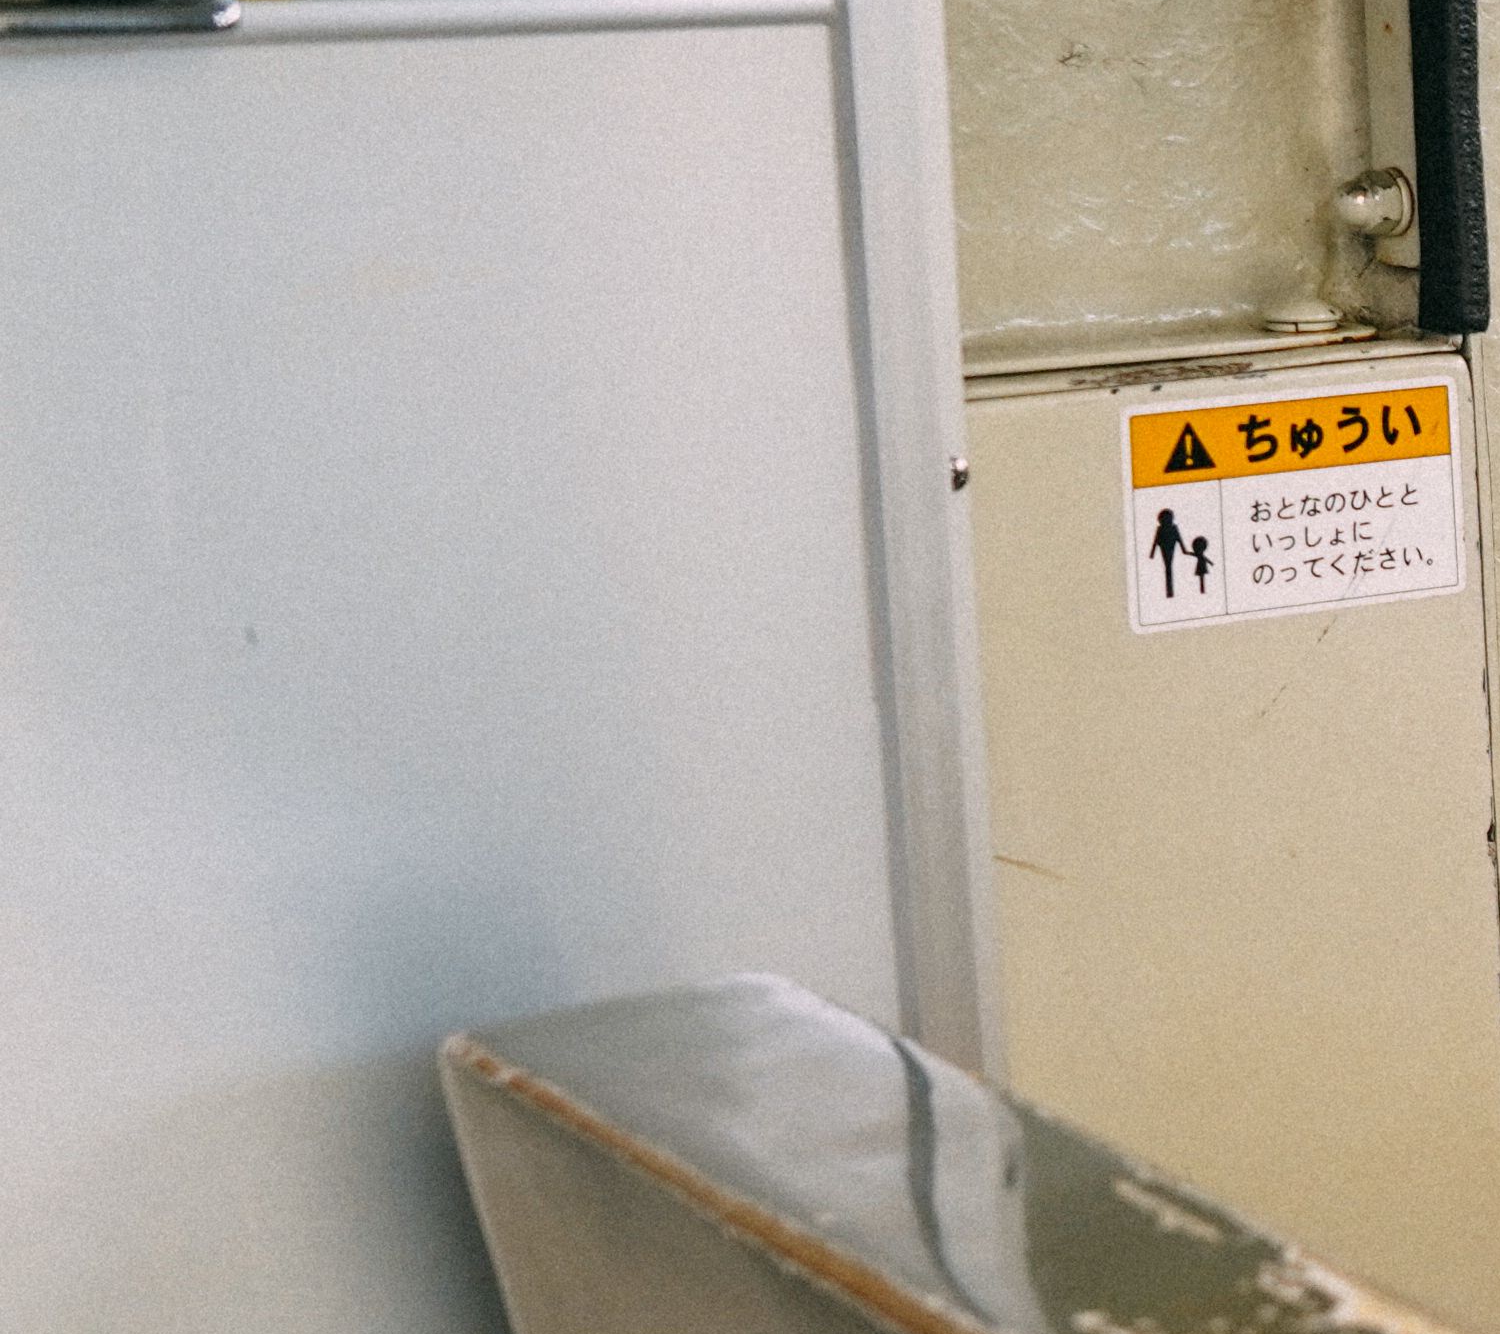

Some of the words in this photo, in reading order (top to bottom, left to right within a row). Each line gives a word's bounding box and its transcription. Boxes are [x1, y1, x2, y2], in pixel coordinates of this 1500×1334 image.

[1237, 404, 1422, 463] ちゅうい
[1251, 483, 1419, 524] おとなのひとと
[1252, 520, 1373, 554] いっしょに
[1252, 546, 1437, 586] のってください。
